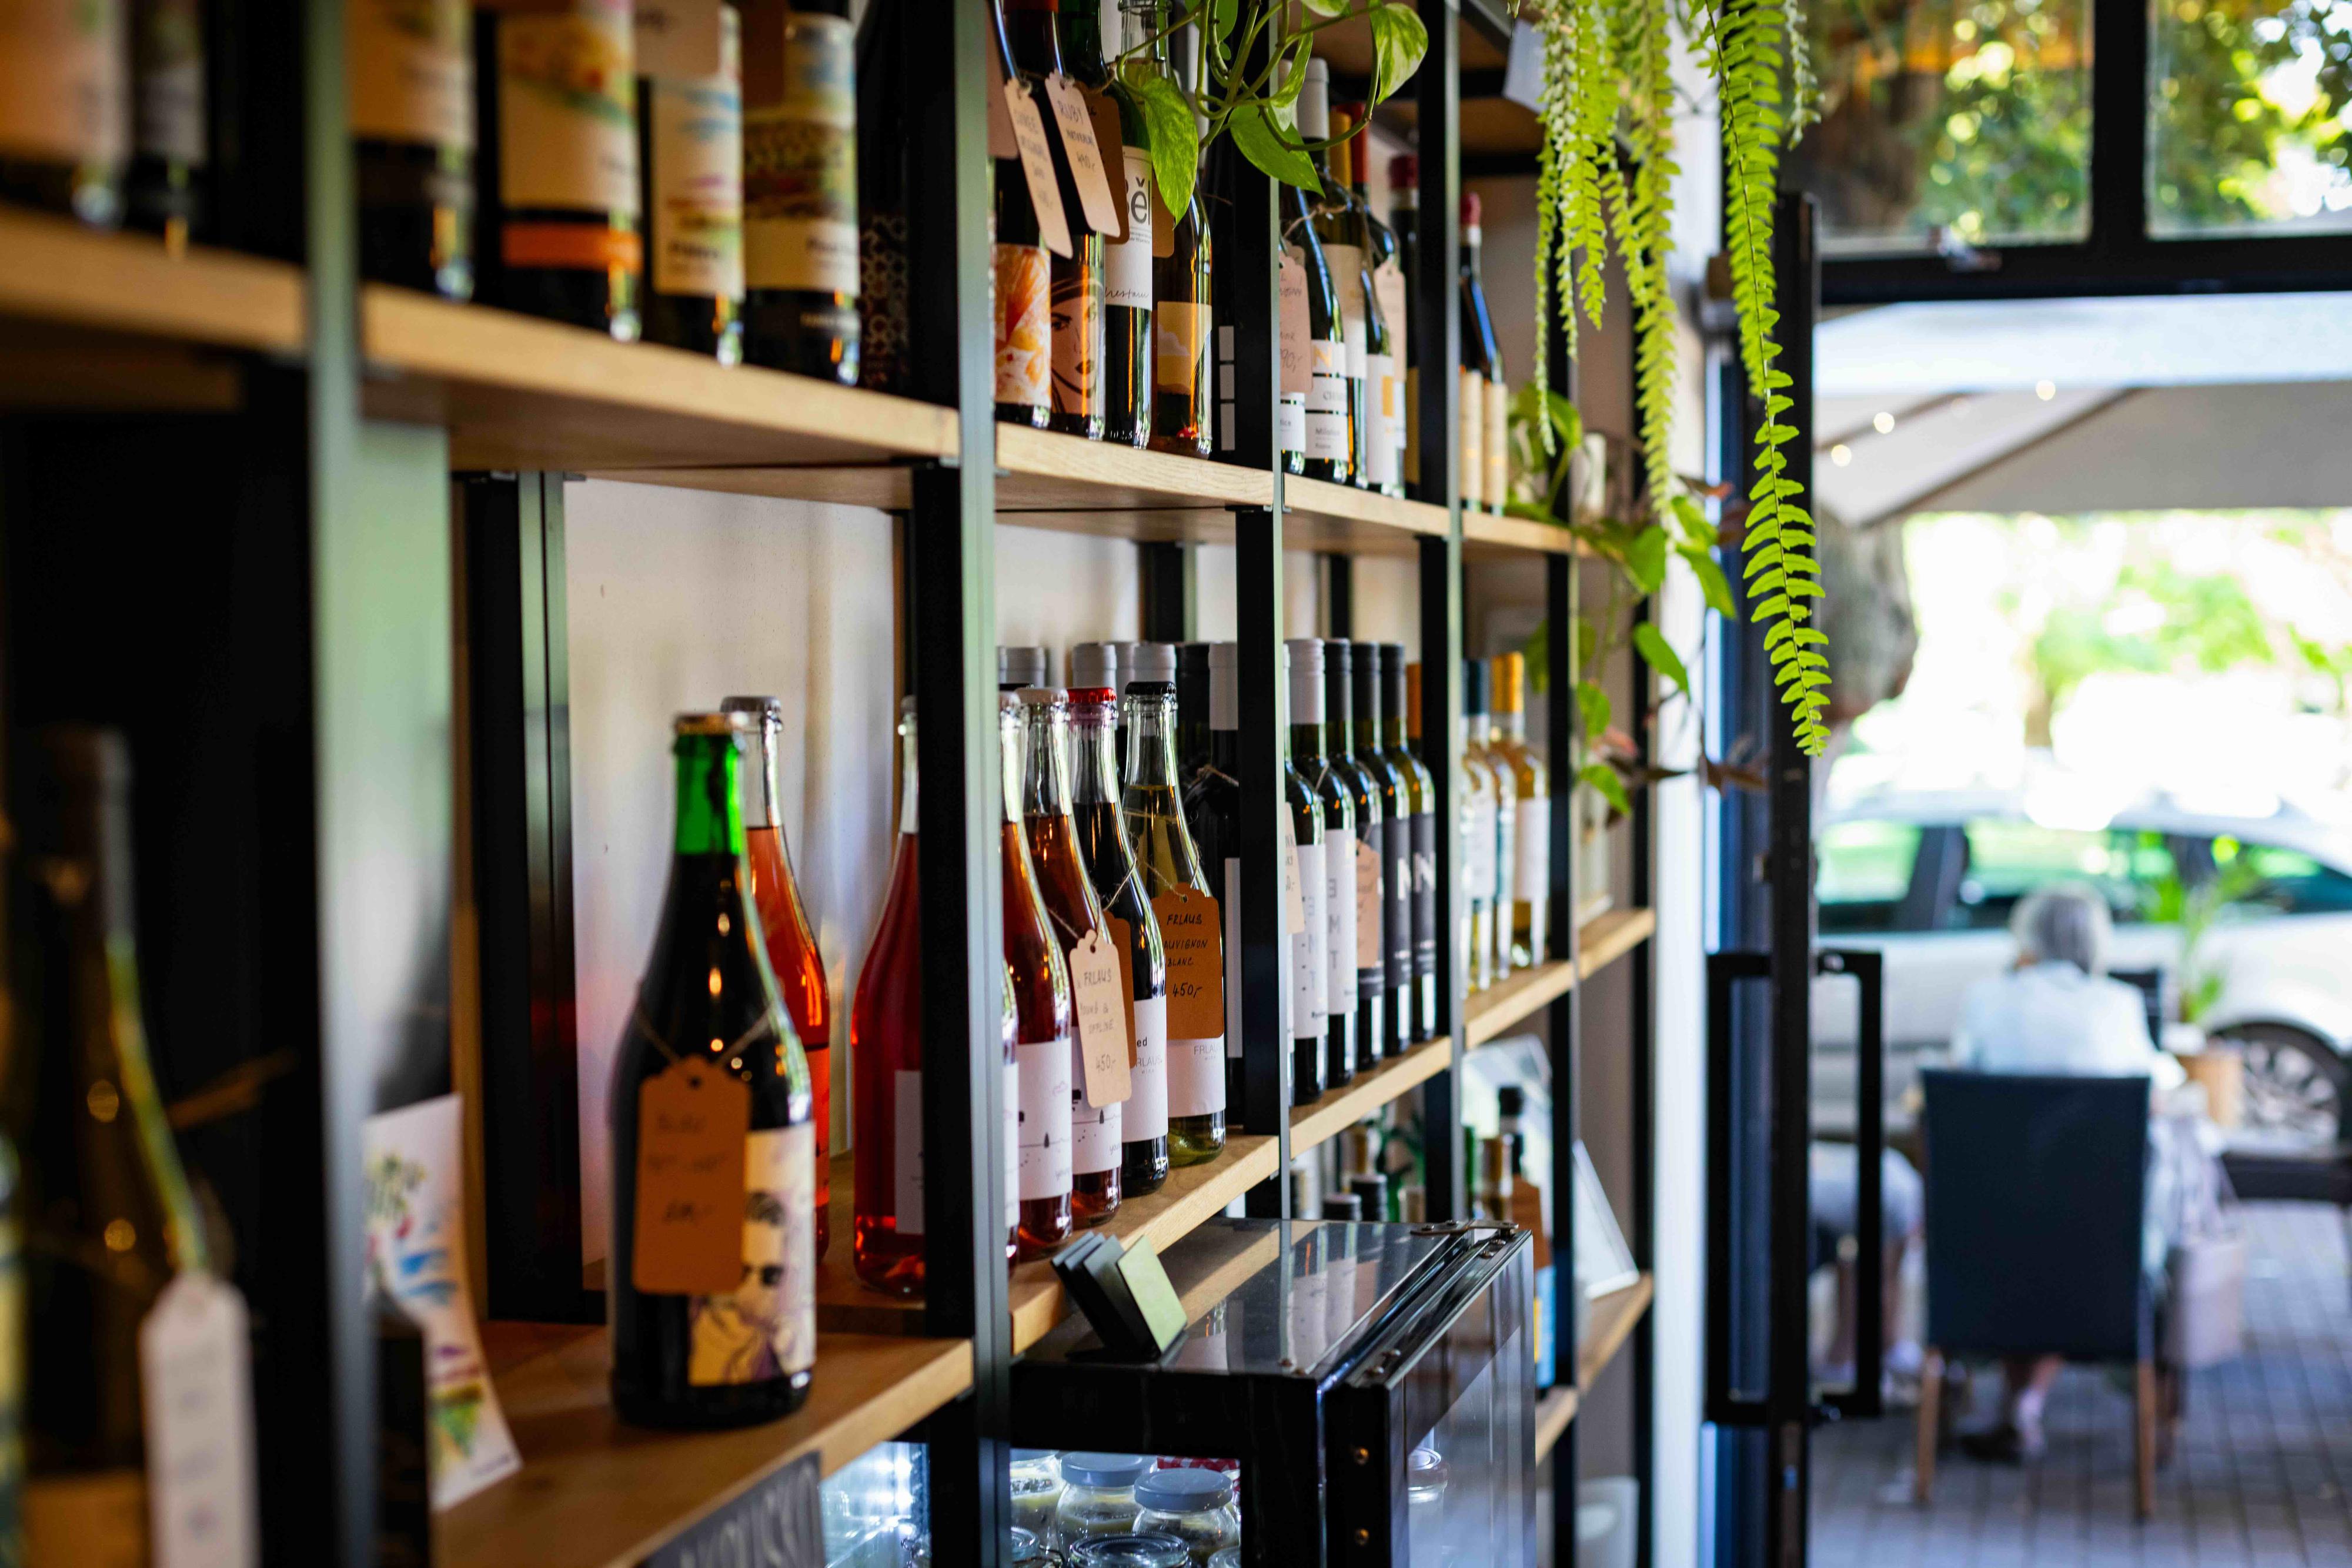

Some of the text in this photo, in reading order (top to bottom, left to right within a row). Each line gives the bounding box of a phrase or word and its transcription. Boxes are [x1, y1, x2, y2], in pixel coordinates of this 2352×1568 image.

[1125, 176, 1150, 225] ěl
[1167, 914, 1202, 925] FRLAUS
[1164, 939, 1208, 951] AUVIGNON
[1084, 968, 1111, 987] FRLAUS
[1135, 1055, 1162, 1068] RLAUS
